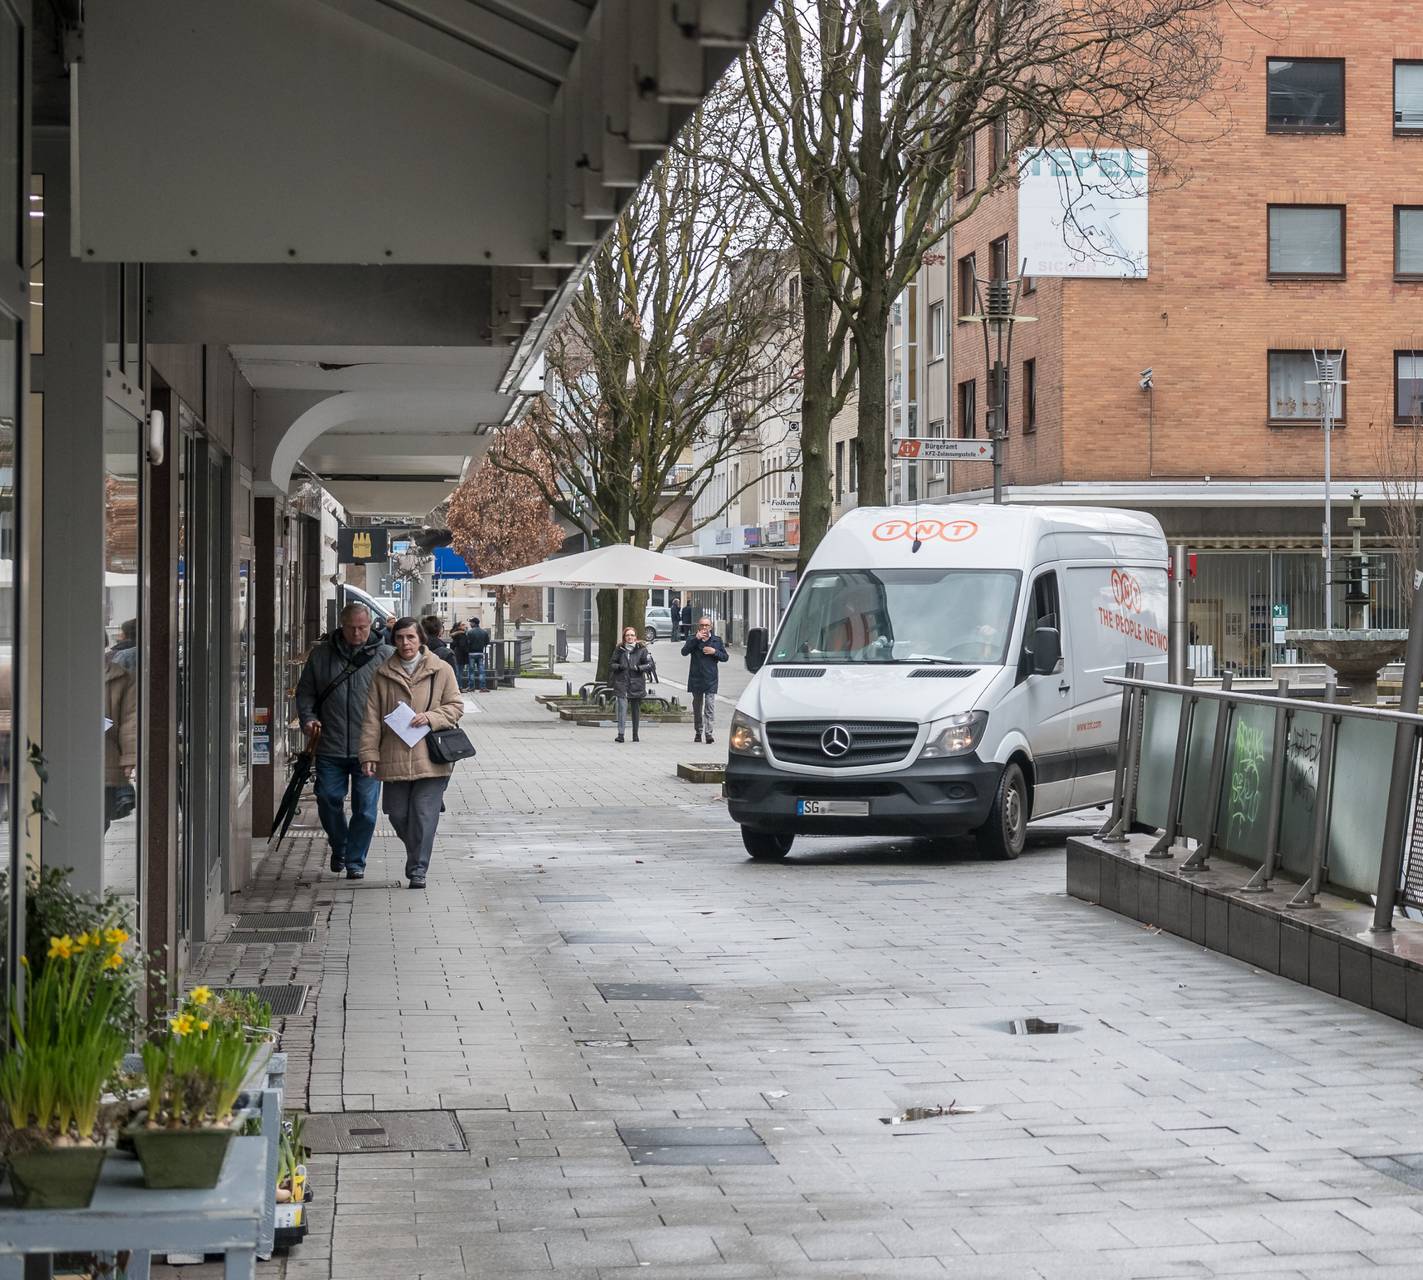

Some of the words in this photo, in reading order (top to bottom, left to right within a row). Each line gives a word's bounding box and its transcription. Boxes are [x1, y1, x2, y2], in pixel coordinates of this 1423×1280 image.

[925, 442, 958, 452] Bürgeramt
[1098, 607, 1114, 629] THE
[1115, 614, 1142, 641] PEOPLE
[804, 801, 819, 814] SG
